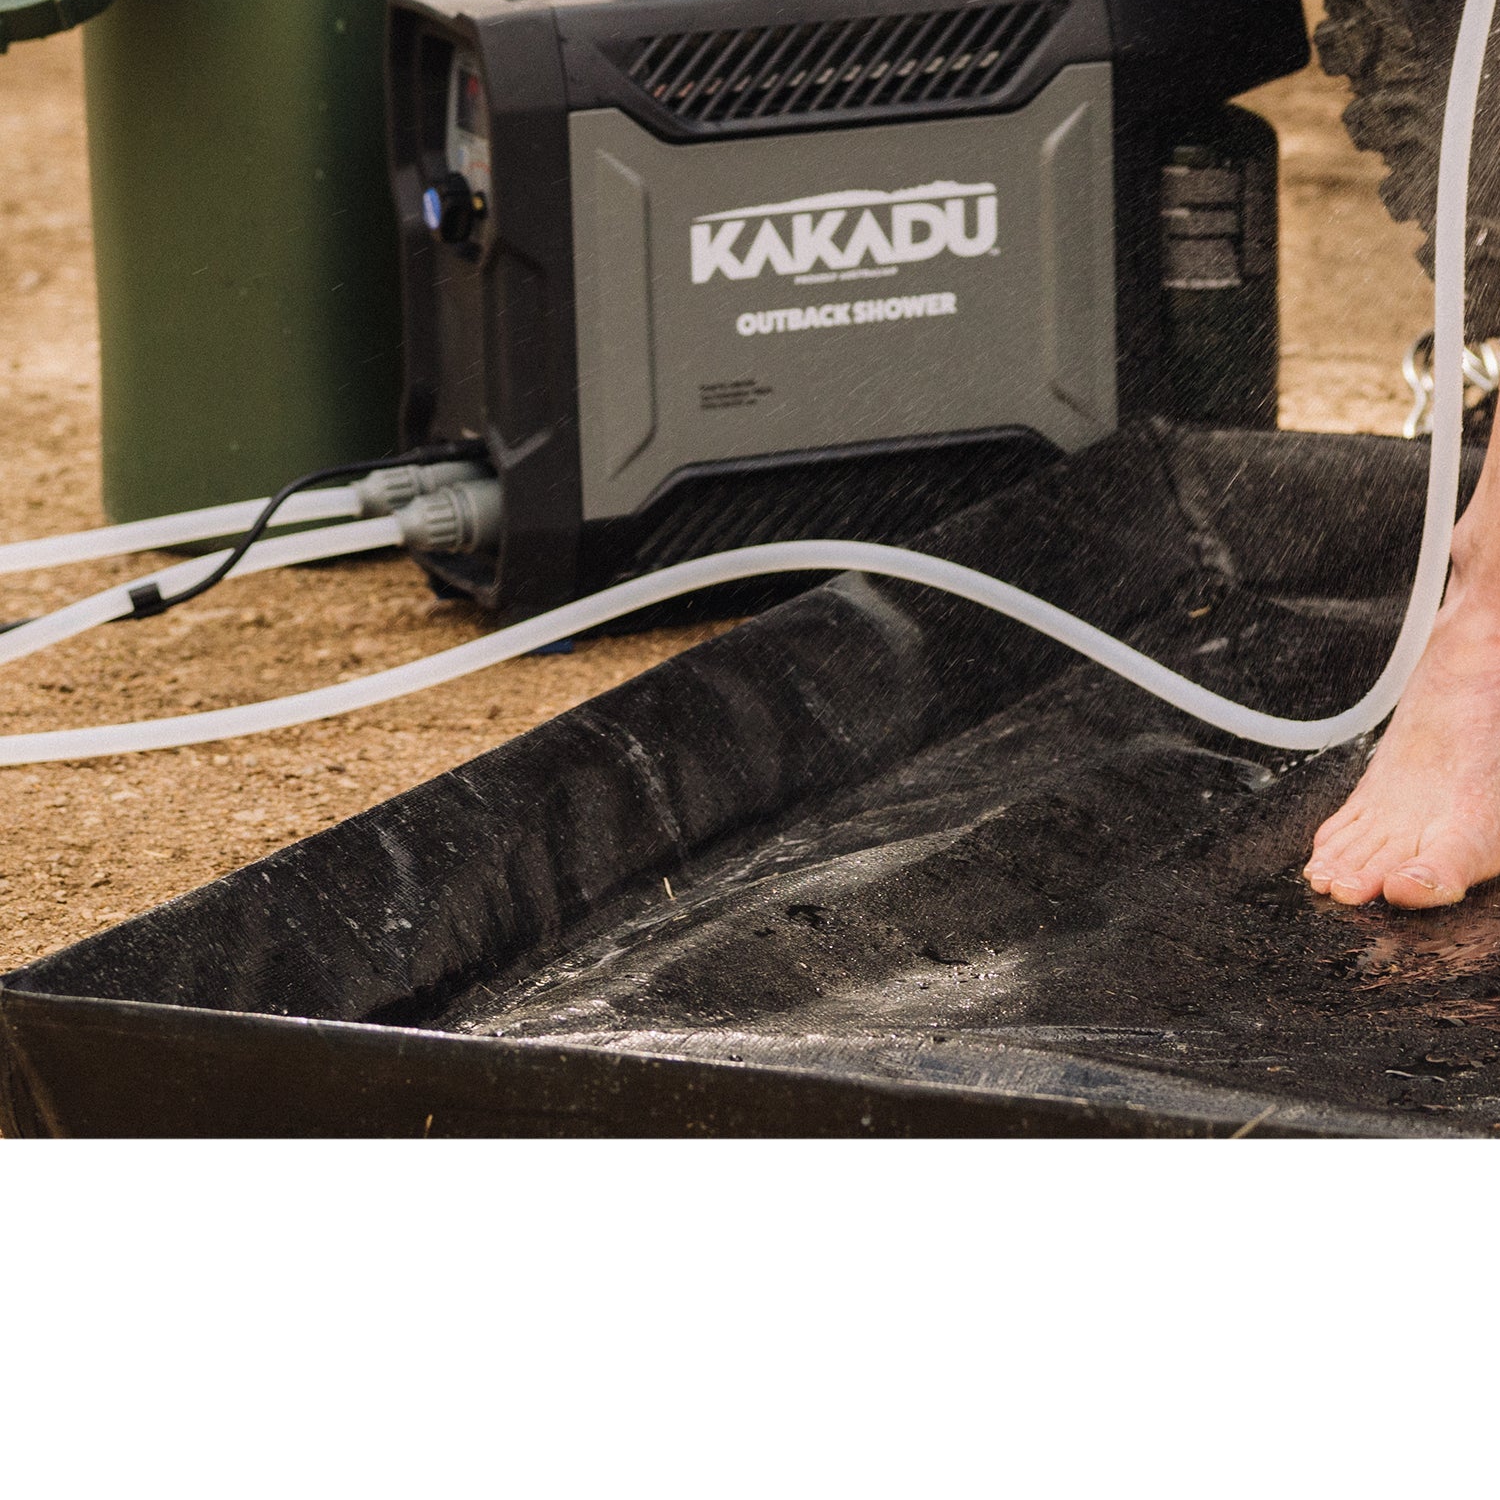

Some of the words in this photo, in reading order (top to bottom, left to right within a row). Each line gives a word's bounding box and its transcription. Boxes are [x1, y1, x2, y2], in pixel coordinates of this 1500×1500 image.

[691, 195, 998, 284] KAKADU
[736, 302, 851, 336] OUTBACK
[852, 291, 958, 324] SHOWER
